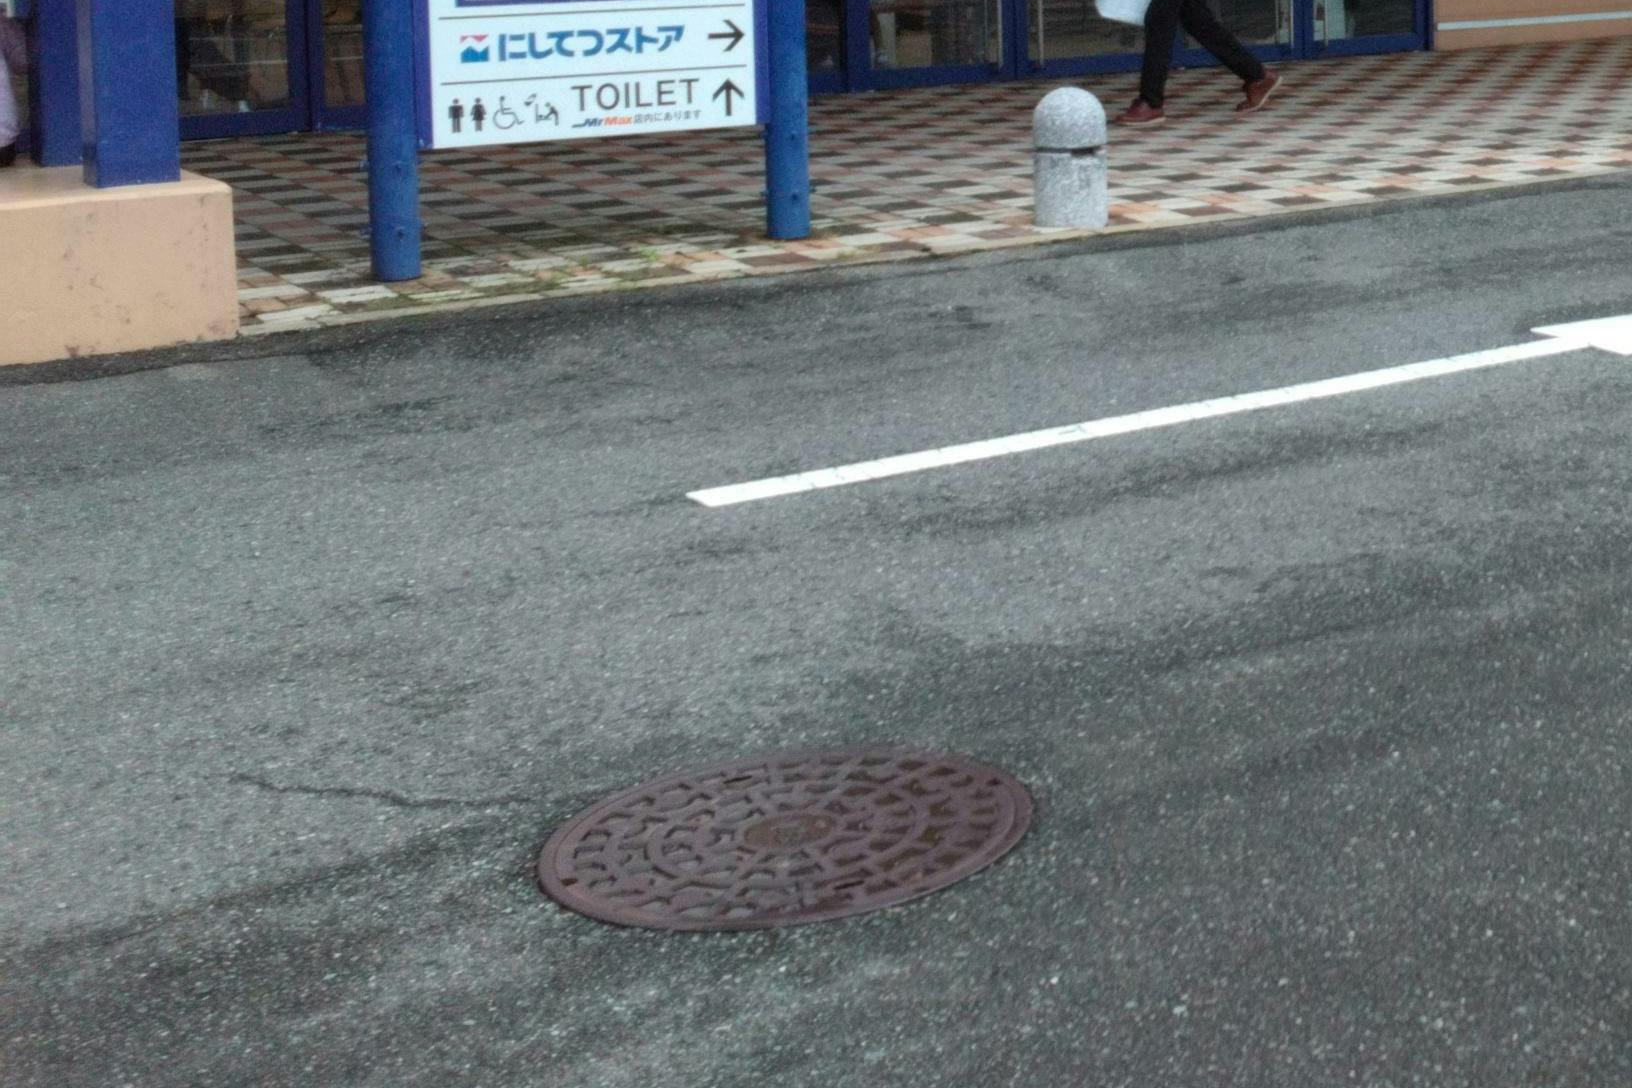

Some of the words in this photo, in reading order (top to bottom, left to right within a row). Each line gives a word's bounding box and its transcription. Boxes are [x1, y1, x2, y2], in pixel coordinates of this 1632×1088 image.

[498, 24, 686, 62] にしてつストア
[571, 78, 699, 111] TOILET
[571, 115, 633, 128] MrMax
[633, 109, 702, 124] 店内にあります
